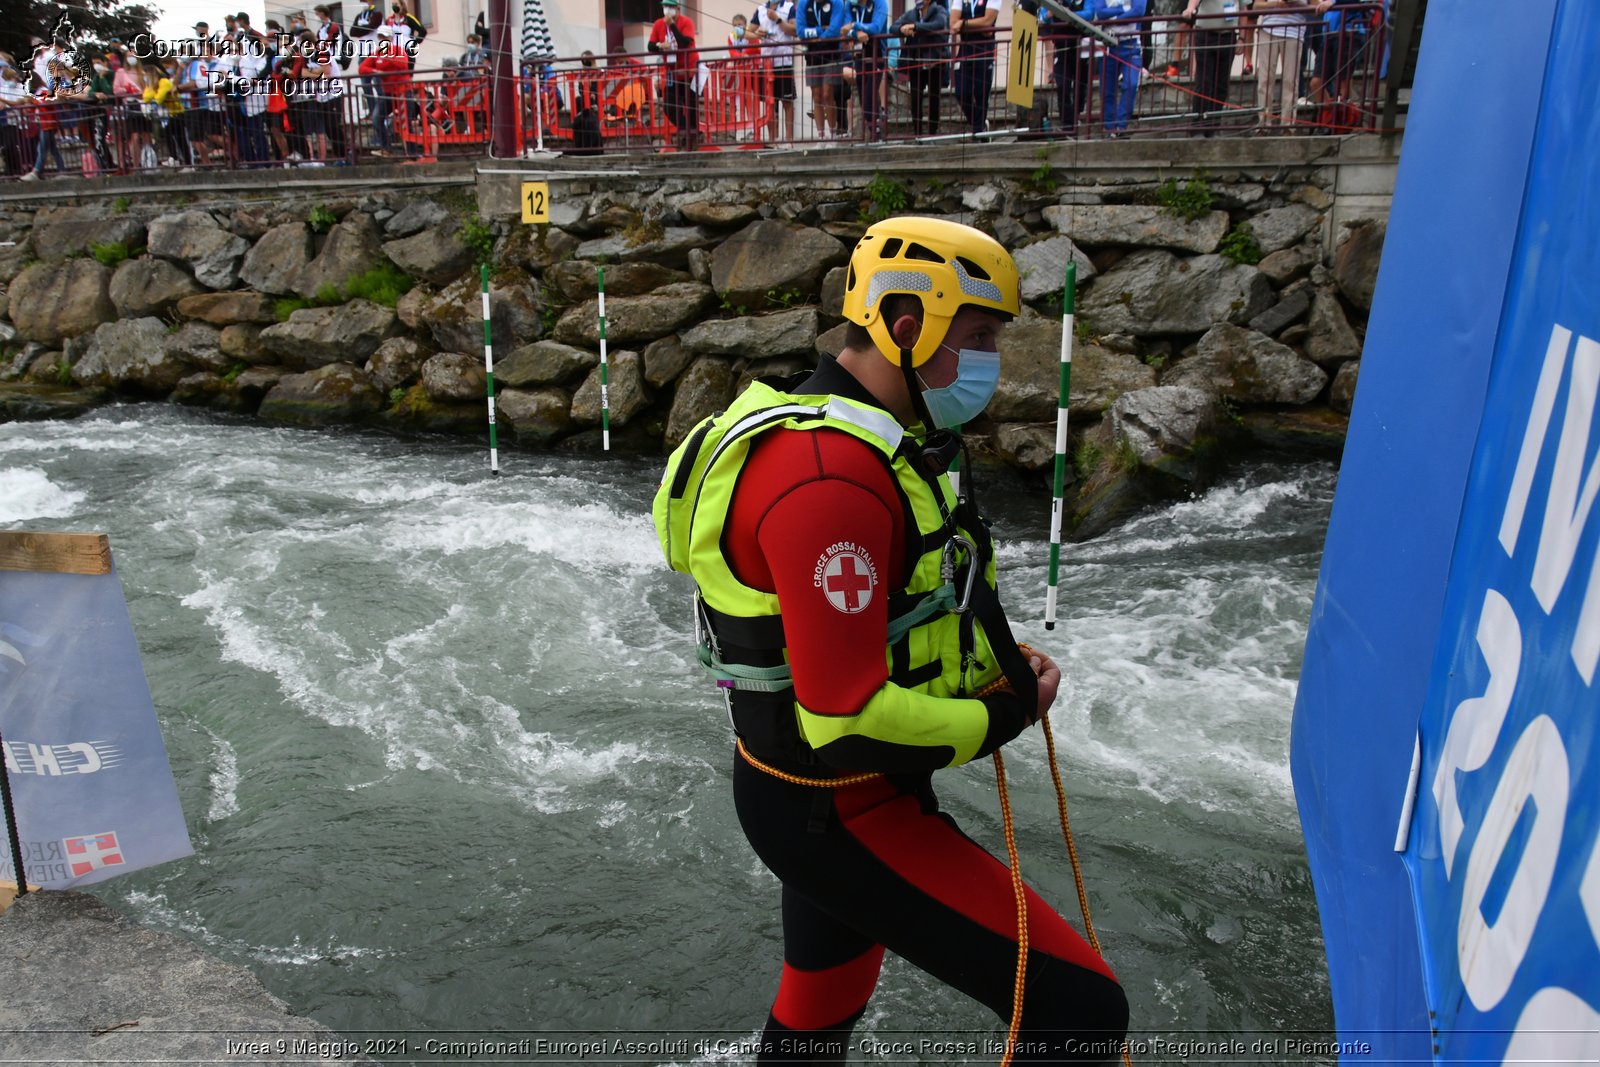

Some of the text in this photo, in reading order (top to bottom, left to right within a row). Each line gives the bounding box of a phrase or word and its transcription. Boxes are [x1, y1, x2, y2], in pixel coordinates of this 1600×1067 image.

[1017, 28, 1033, 88] 11
[527, 190, 544, 216] 12
[813, 541, 879, 588] CROCE ROSSA ITALIANA
